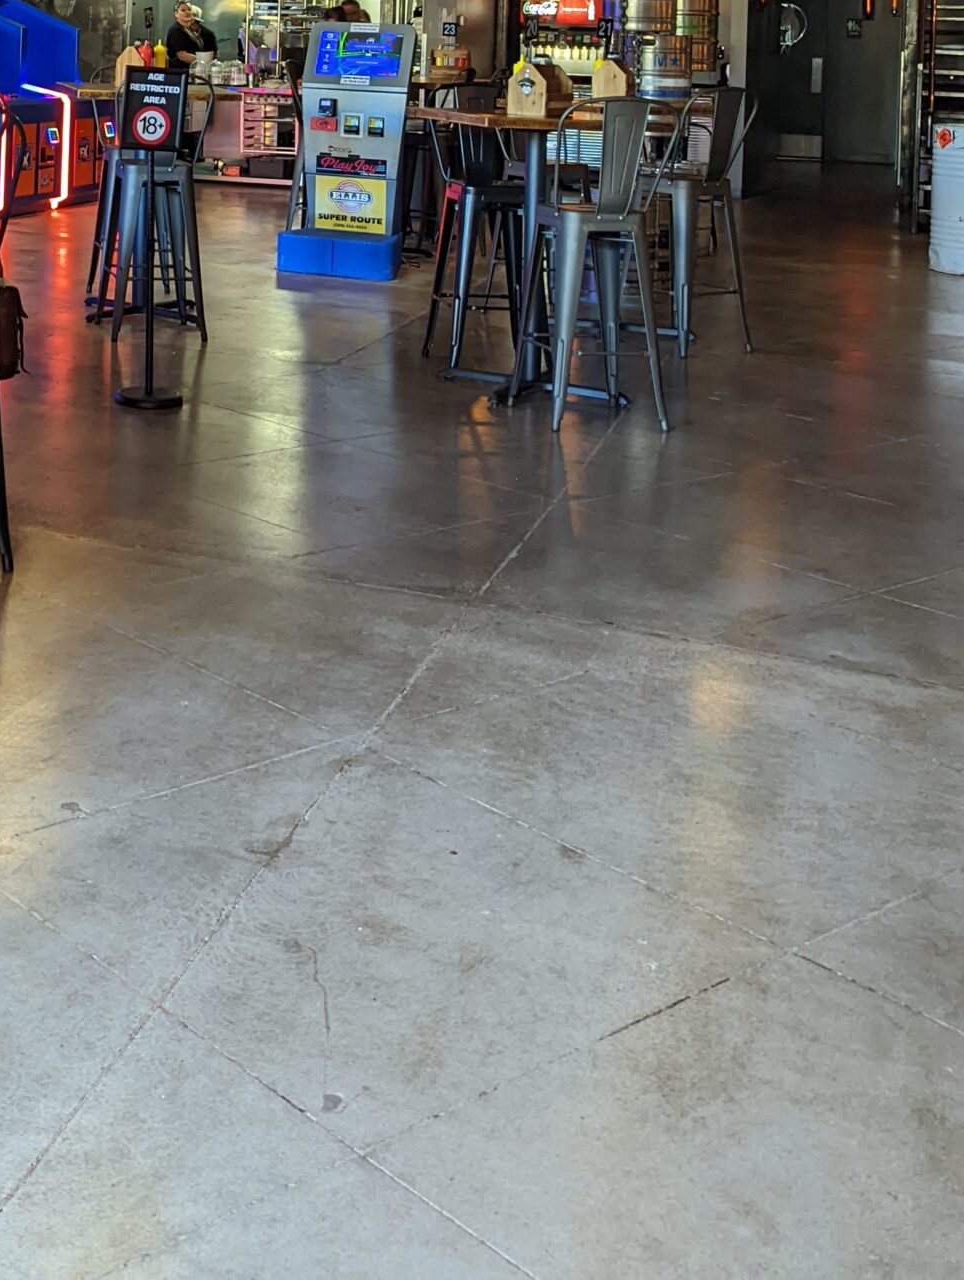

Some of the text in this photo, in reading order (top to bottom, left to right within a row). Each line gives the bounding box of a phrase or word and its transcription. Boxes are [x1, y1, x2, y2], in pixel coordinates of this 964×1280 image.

[443, 24, 456, 35] 23
[599, 22, 612, 36] 21
[653, 54, 668, 67] M
[147, 72, 166, 81] AGE
[129, 83, 180, 94] RESTRICTED
[143, 95, 167, 105] AREA
[139, 116, 165, 135] 18+
[321, 156, 354, 173] Play
[331, 191, 370, 202] ELLIS
[318, 213, 383, 225] SUPER ROUTE
